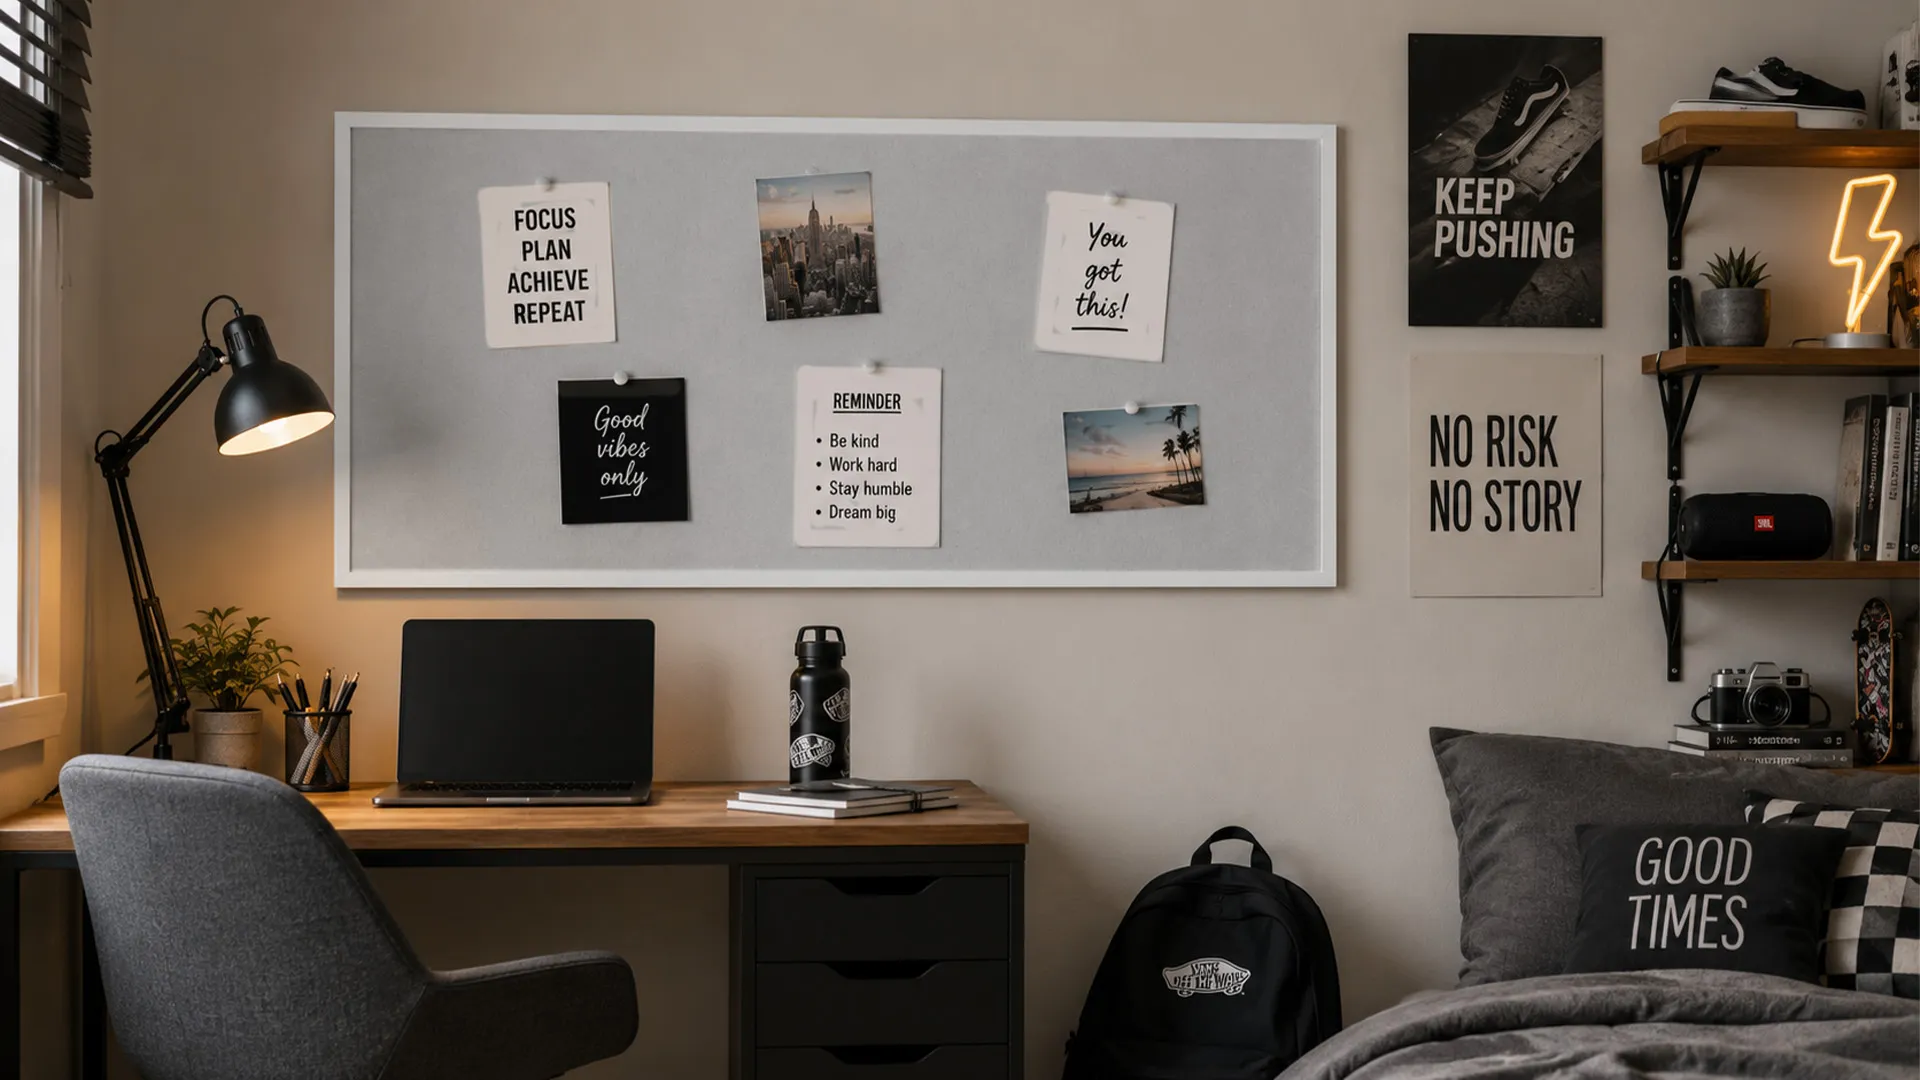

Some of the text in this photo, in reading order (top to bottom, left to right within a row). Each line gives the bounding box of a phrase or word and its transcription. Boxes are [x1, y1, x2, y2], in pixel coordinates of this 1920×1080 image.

[1435, 177, 1515, 215] KEEP
[514, 207, 576, 232] FOCUS
[521, 238, 572, 262] PLAN
[1088, 221, 1129, 251] You
[1434, 219, 1575, 259] PUSHING
[507, 268, 590, 294] ACHIEVE
[1084, 258, 1124, 290] got
[513, 299, 586, 325] REPEAT
[1075, 292, 1130, 320] this!
[833, 392, 901, 410] REMINDER
[594, 402, 650, 435] Good
[597, 432, 650, 459] vibes
[830, 433, 879, 449] Be kind
[1430, 414, 1559, 468] NO RISK
[600, 460, 649, 497] only
[829, 457, 897, 472] Work hard
[829, 480, 913, 500] Stay humble
[829, 504, 896, 524] Dream big
[1430, 479, 1583, 533] NO STORY
[1635, 836, 1753, 886] GOOD
[1628, 893, 1747, 950] TIMES
